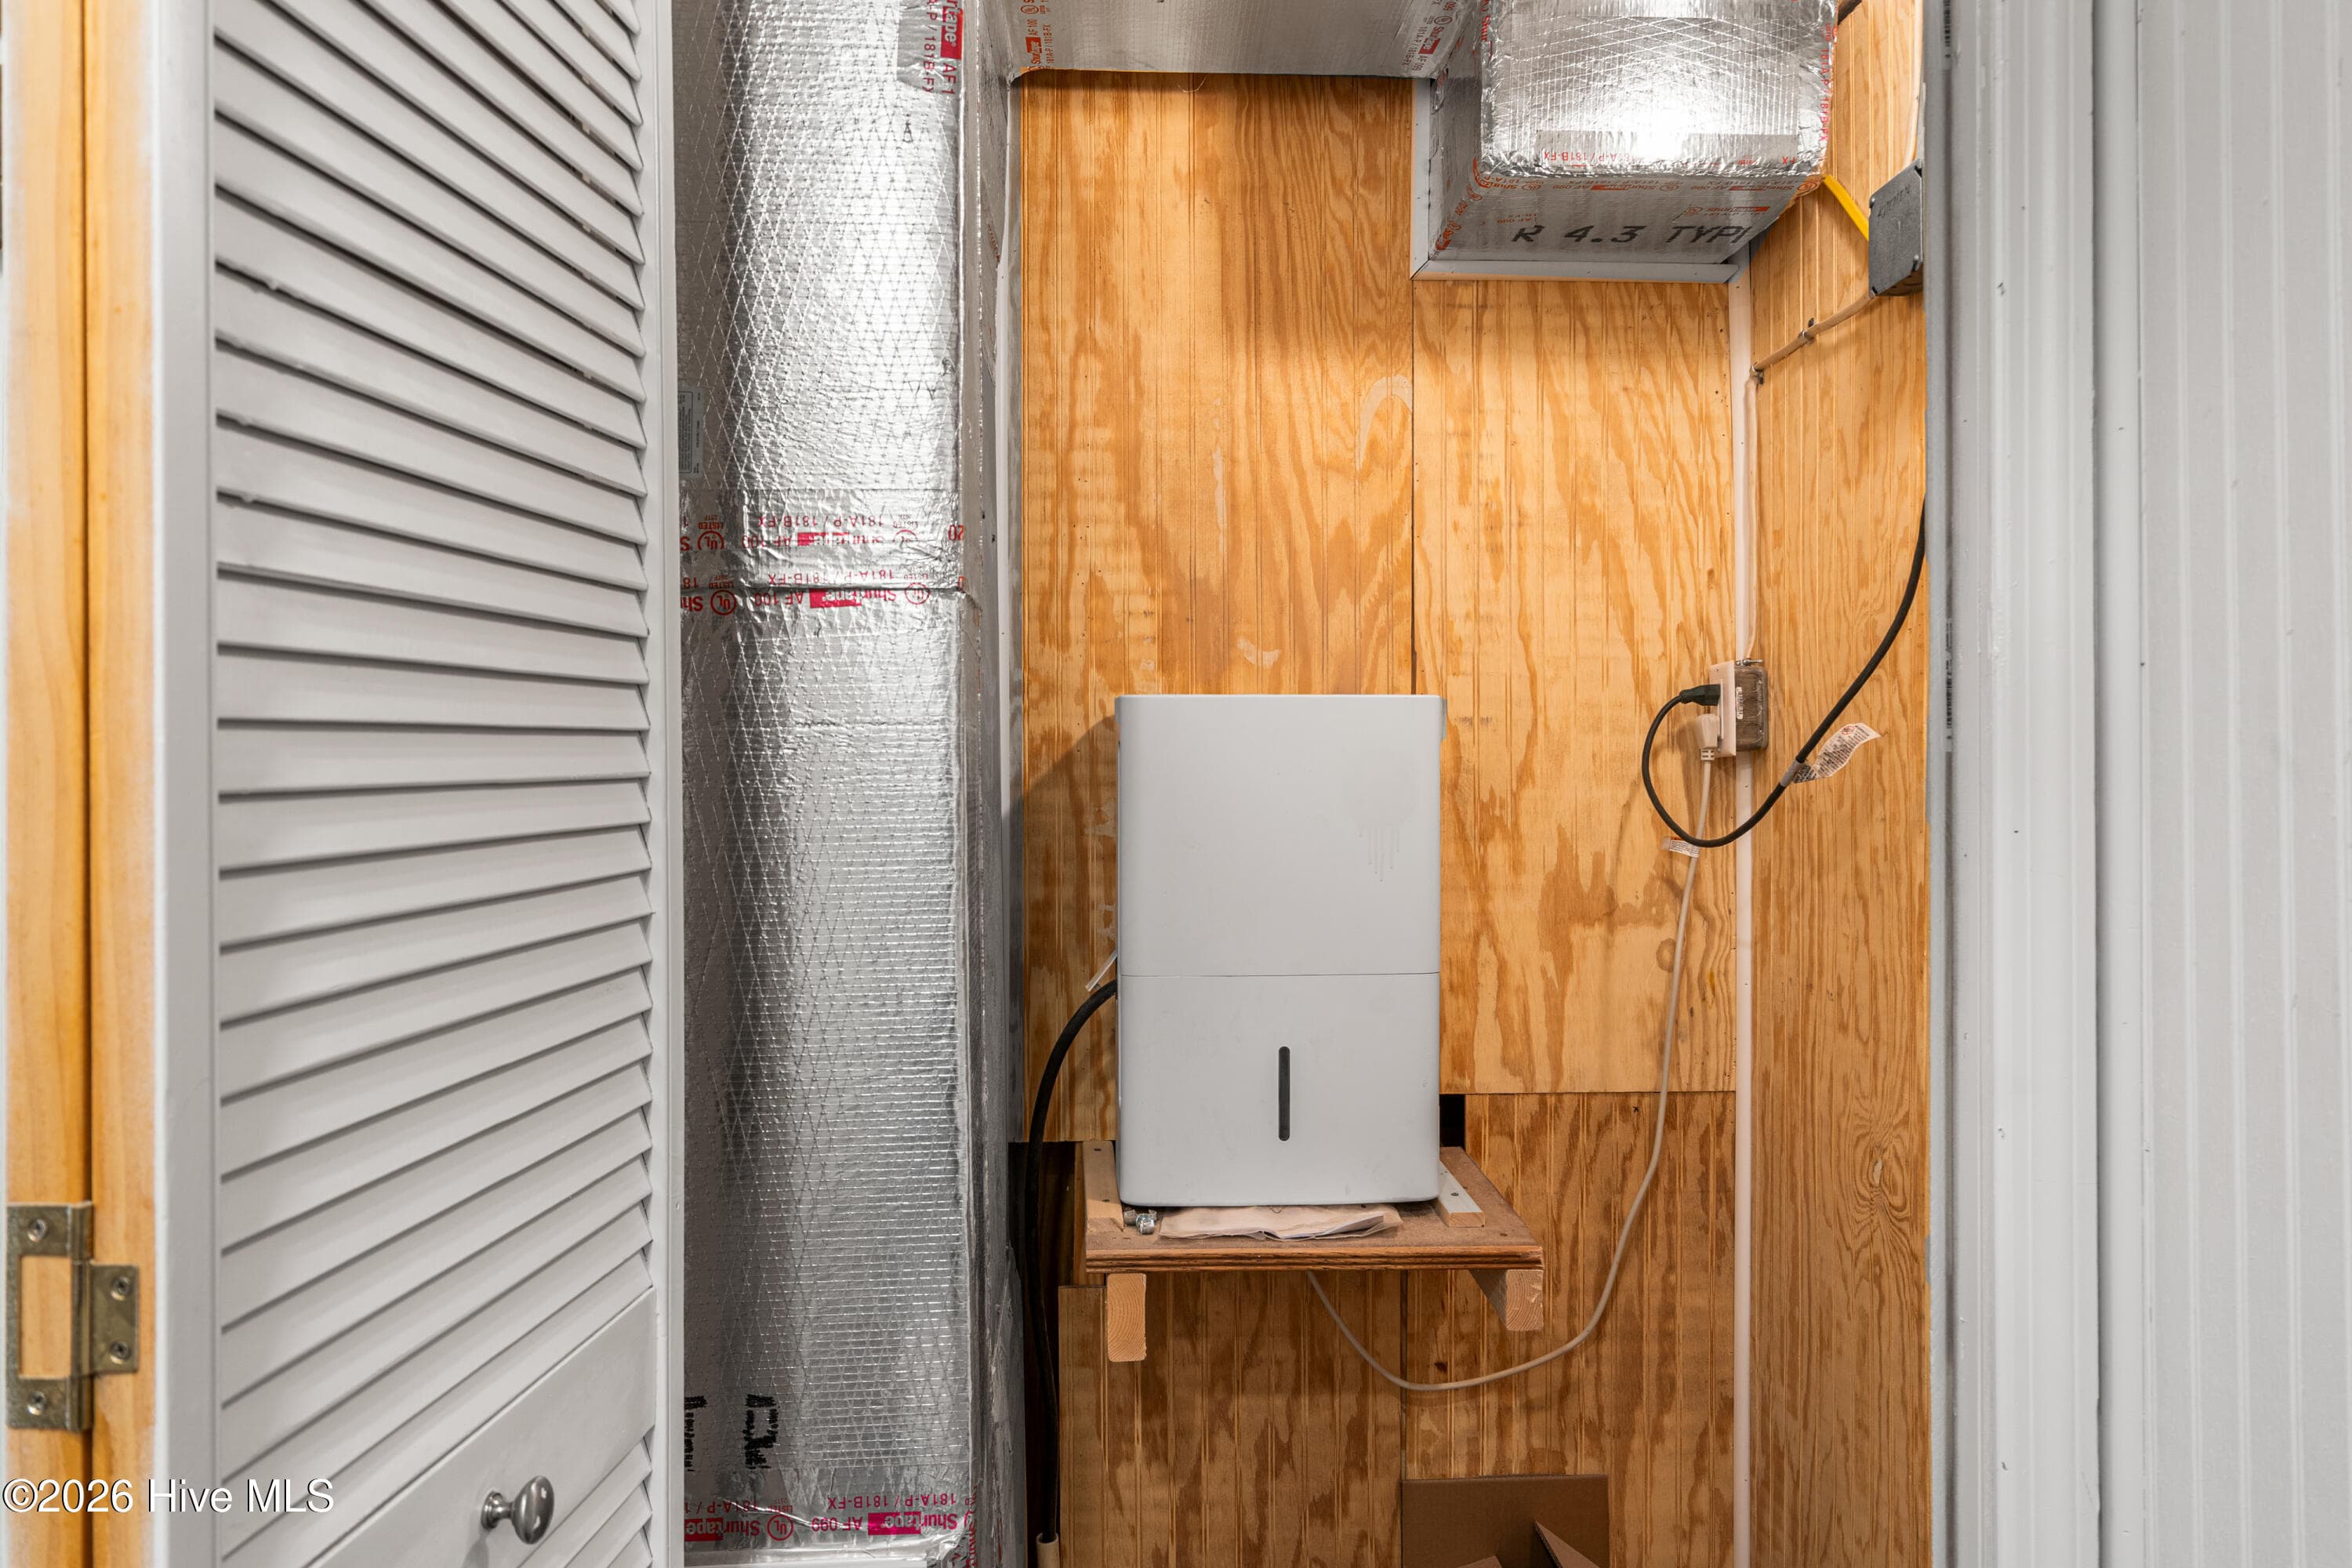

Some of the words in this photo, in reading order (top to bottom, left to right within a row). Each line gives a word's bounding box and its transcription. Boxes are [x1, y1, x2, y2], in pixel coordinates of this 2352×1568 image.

[942, 63, 957, 84] AF
[1512, 225, 1544, 241] R
[1564, 225, 1647, 242] 4.3
[757, 515, 818, 528] 181B-FX
[833, 515, 884, 528] 181A-P
[754, 591, 779, 607] 100
[785, 590, 804, 604] AF
[828, 1495, 887, 1509] 181B-FX
[905, 1493, 956, 1507] 181A-P
[686, 1519, 760, 1537] Shurtape
[811, 1517, 838, 1532] 099
[842, 1516, 863, 1532] AF
[880, 1514, 958, 1530] Shurtape
